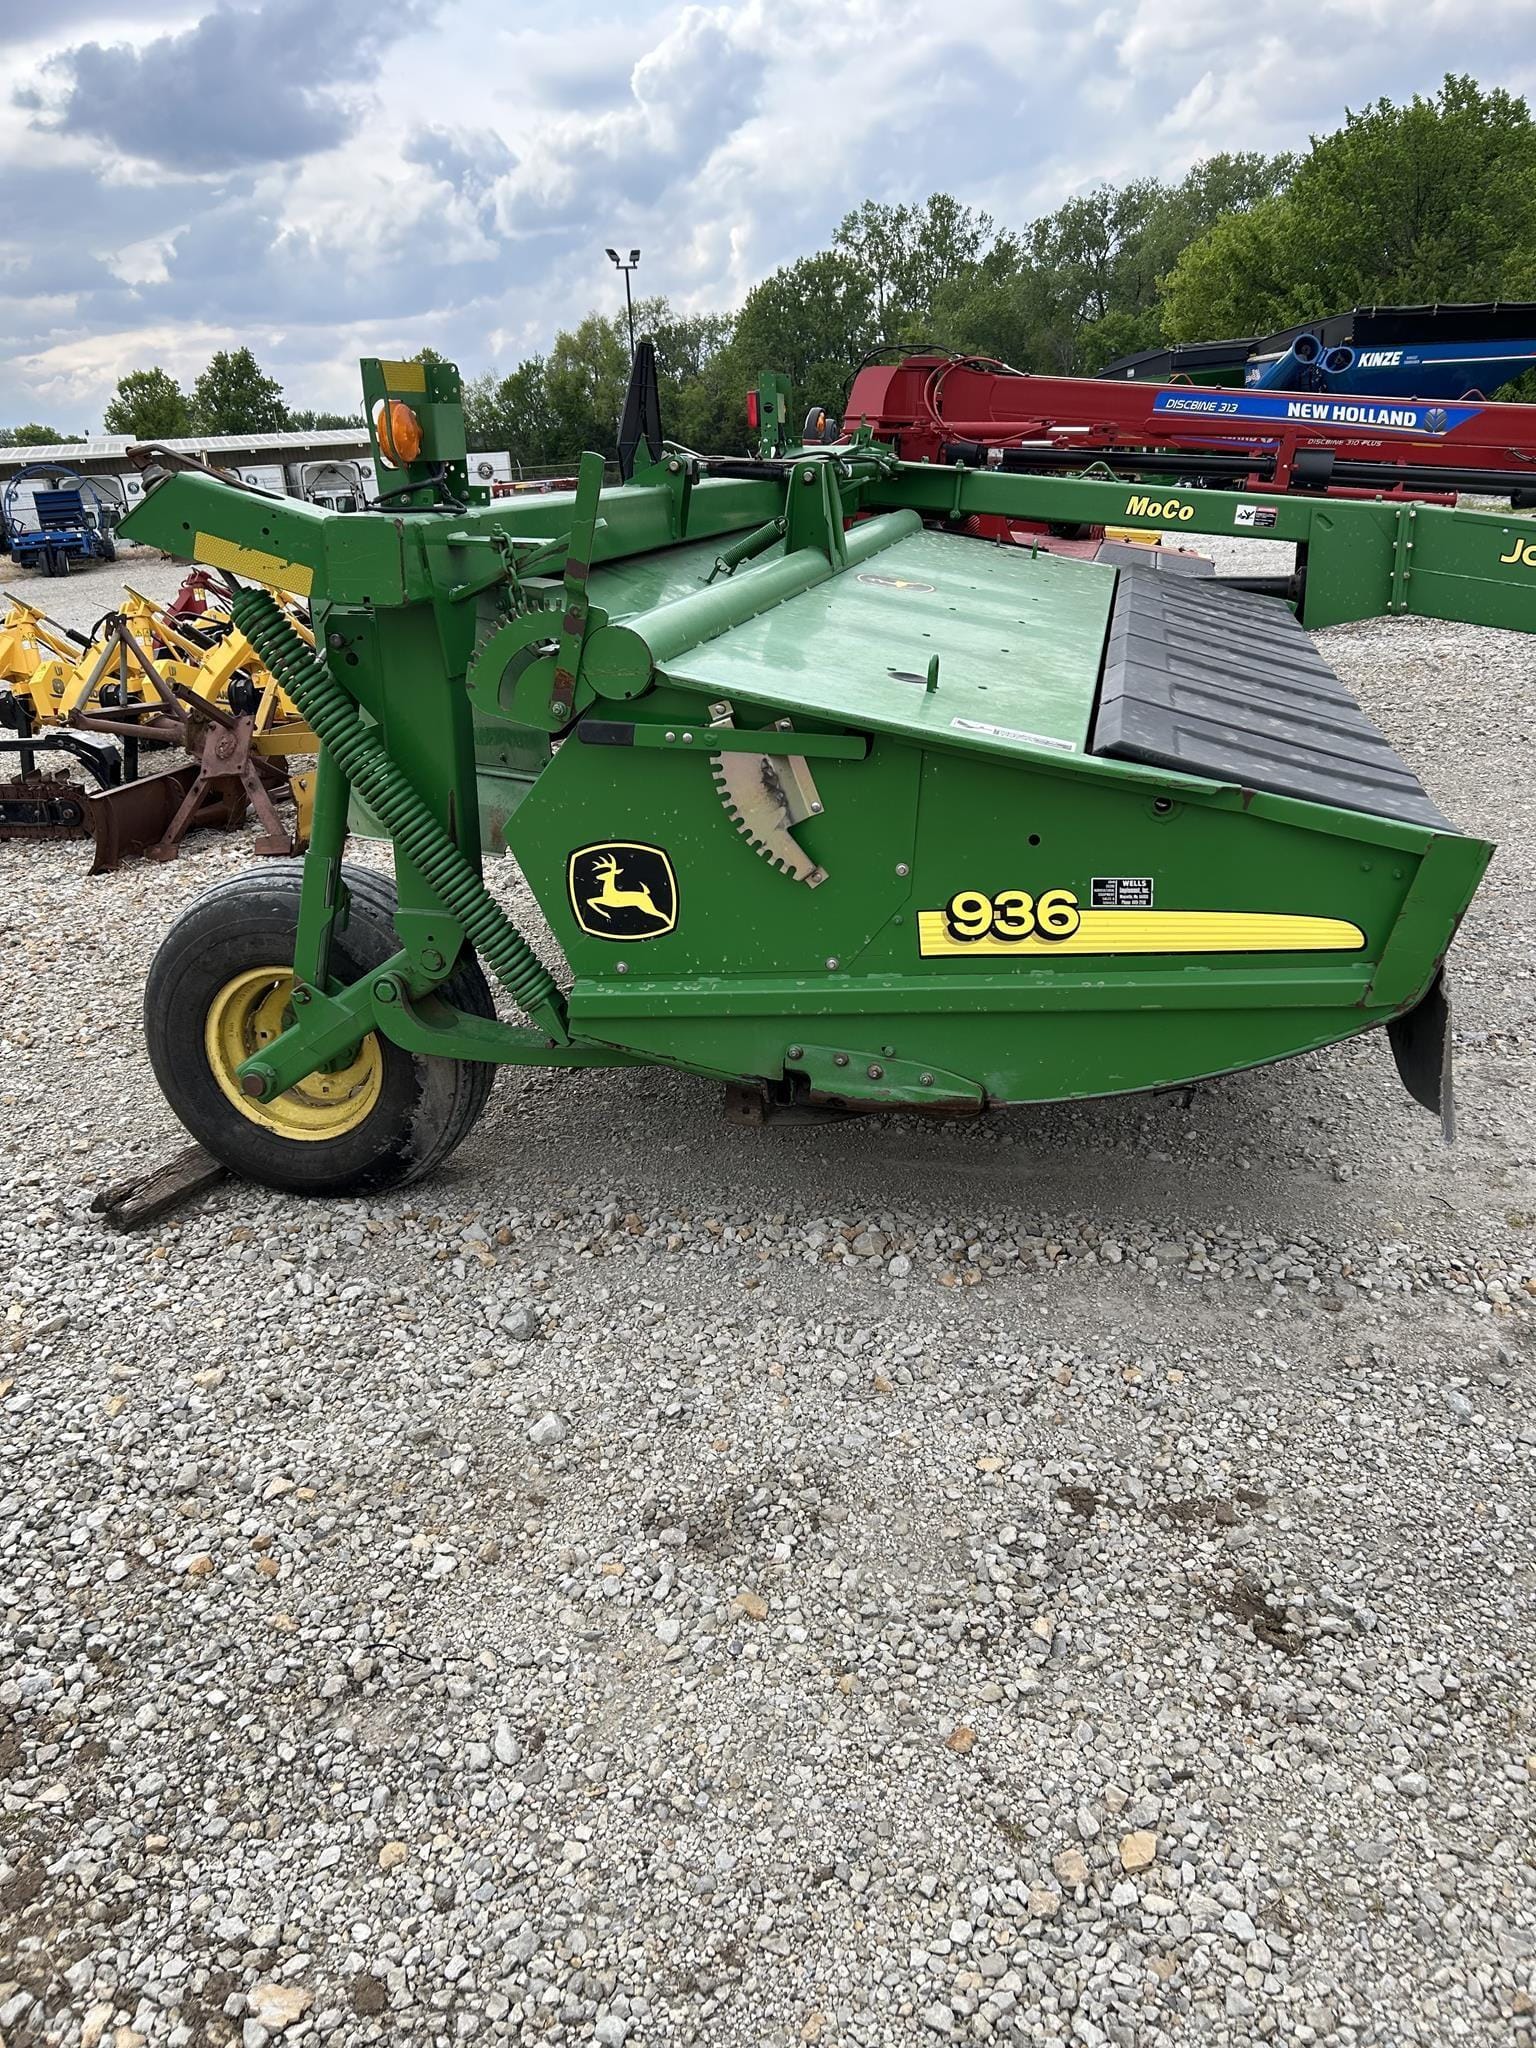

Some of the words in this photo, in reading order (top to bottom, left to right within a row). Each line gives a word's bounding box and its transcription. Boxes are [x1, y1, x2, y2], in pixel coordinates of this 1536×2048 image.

[1357, 350, 1404, 368] KINZE
[1165, 398, 1218, 411] DISCBINE
[1218, 402, 1239, 413] 313
[1287, 402, 1329, 419] NEW
[1332, 406, 1417, 427] HOLLAND
[1307, 438, 1344, 446] DISCBINE
[1361, 439, 1383, 447] PLUS
[1125, 495, 1195, 521] MoCo
[948, 888, 1080, 940] 936
